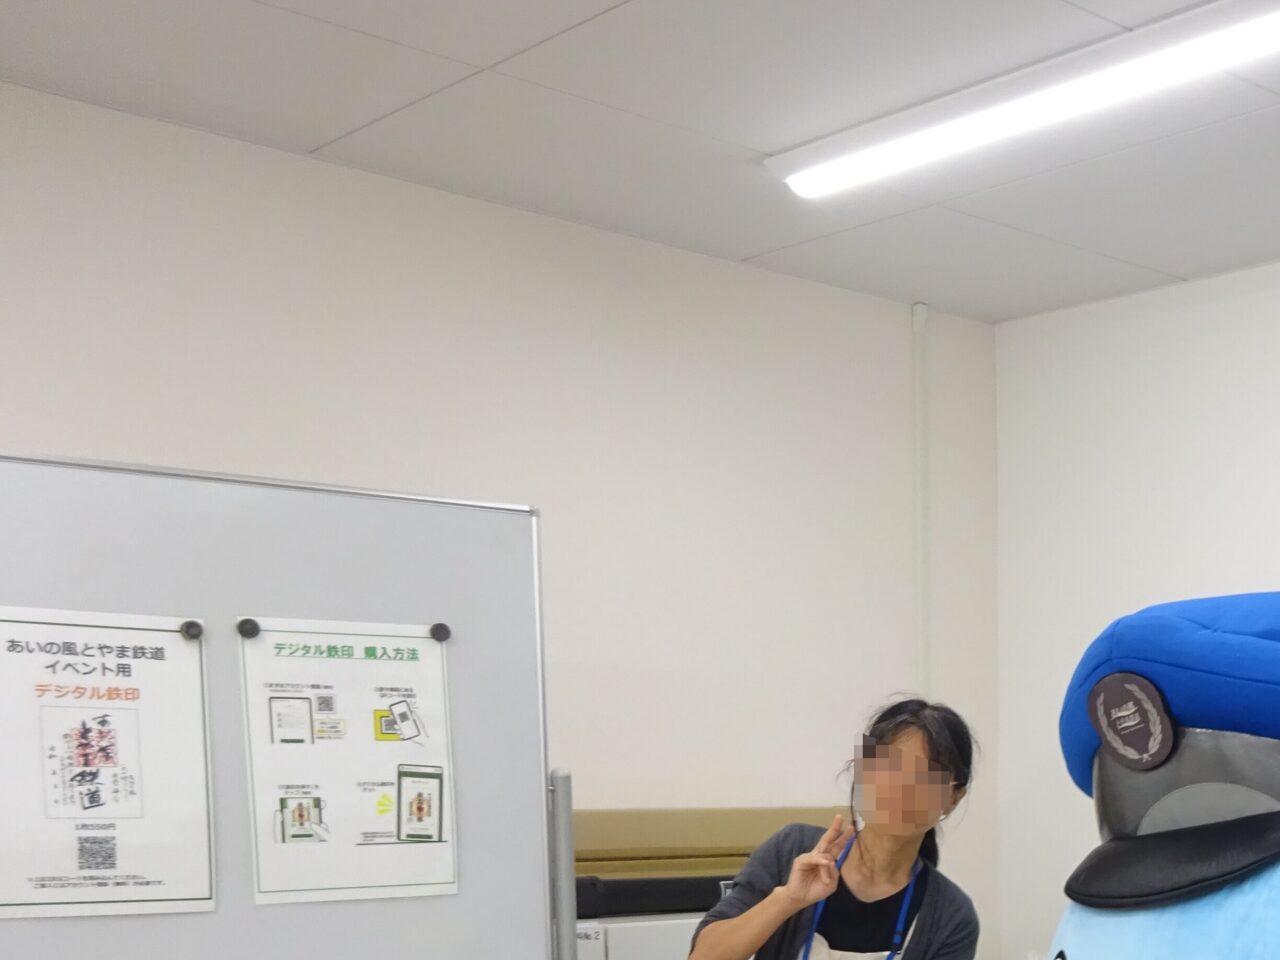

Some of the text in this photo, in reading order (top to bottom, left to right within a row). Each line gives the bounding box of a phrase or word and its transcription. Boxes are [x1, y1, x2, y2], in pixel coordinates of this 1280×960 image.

[6, 638, 166, 661] あいの風とやま鉄道
[274, 643, 355, 658] デジタル鉄印
[44, 660, 132, 677] イベント用
[34, 683, 140, 702] デジタル鉄印
